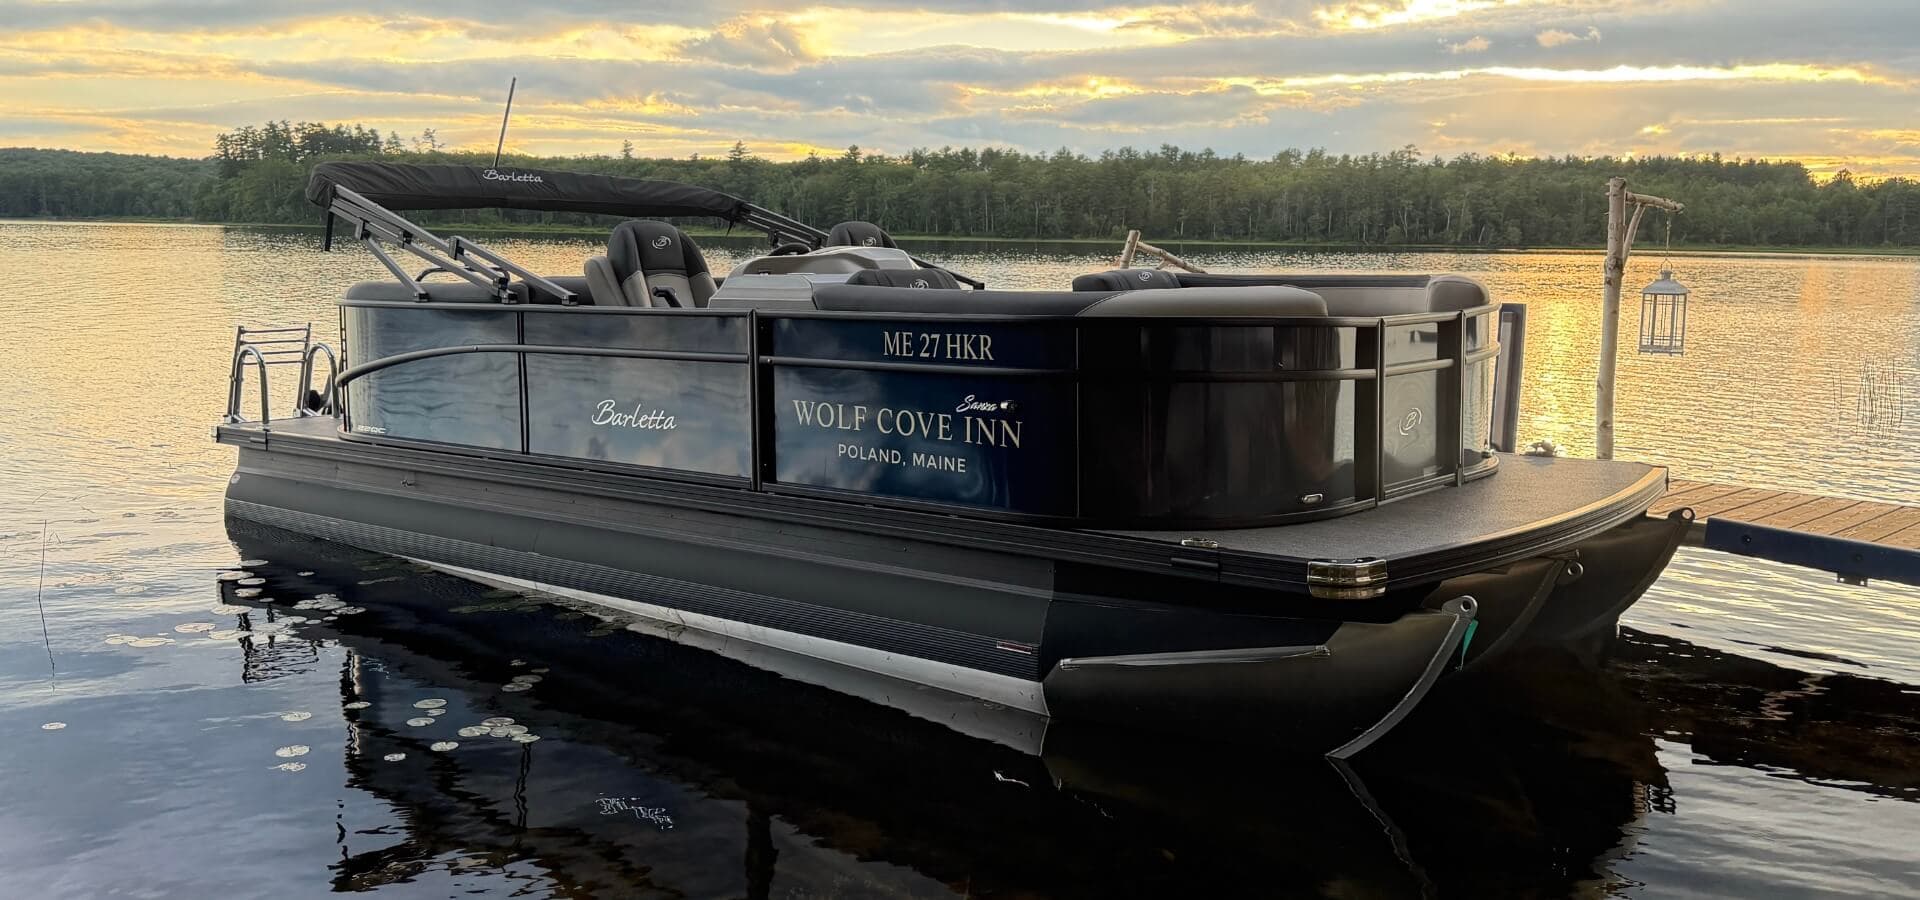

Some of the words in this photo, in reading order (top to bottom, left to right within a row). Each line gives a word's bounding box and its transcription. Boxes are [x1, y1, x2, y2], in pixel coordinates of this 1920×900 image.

[482, 169, 543, 183] Barletta
[884, 331, 914, 357] ME
[919, 333, 941, 358] 27
[946, 333, 995, 361] HKR
[591, 399, 678, 430] Barletta
[793, 400, 868, 431] WOLF
[877, 407, 953, 441] COVE
[963, 416, 1023, 449] INN
[838, 443, 906, 466] POLAND,
[913, 452, 967, 473] MAINE
